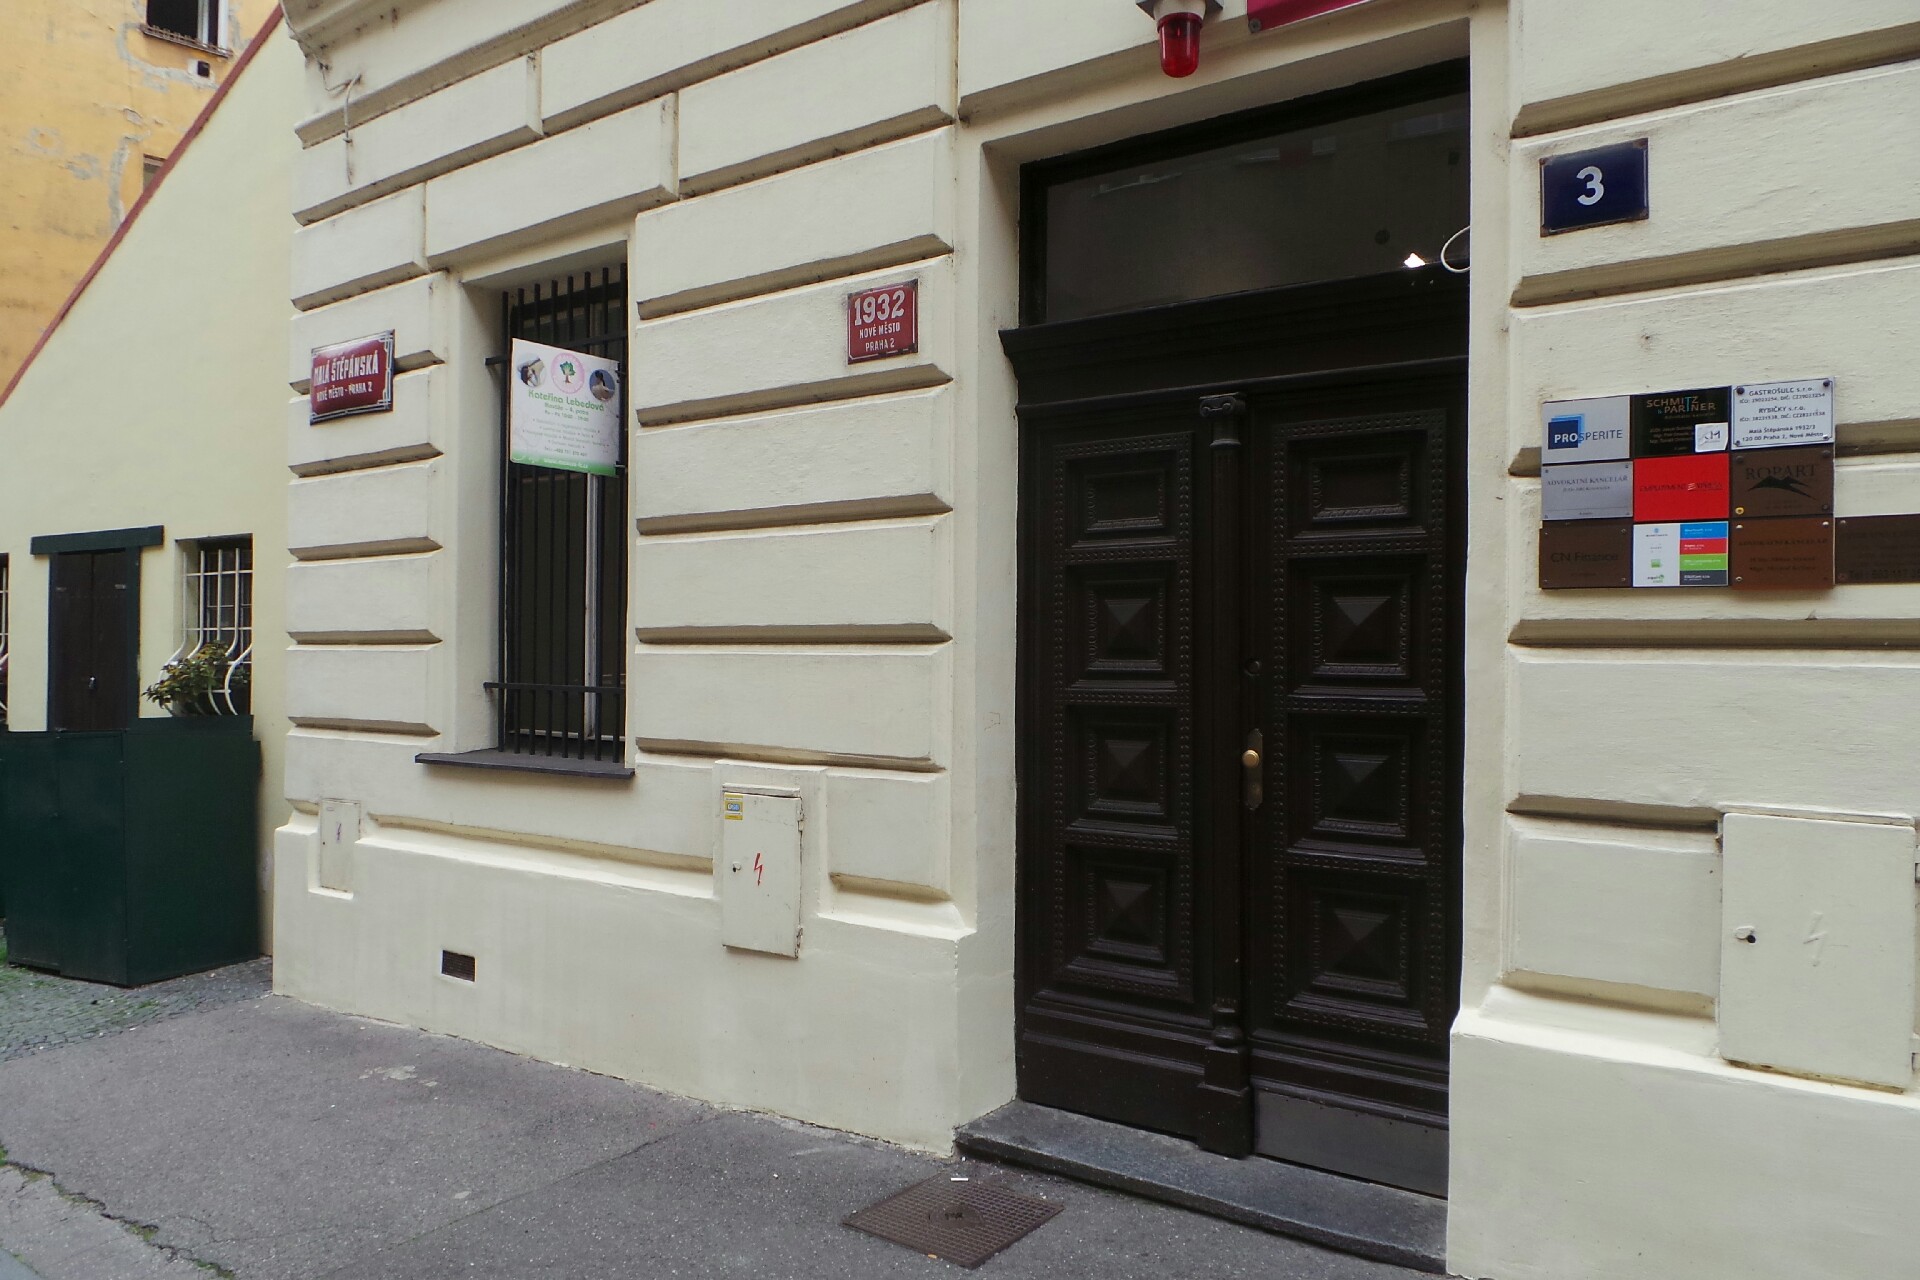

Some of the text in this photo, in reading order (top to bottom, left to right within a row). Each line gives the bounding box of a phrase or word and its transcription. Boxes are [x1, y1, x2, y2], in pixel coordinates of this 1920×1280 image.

[1576, 165, 1605, 206] 3
[854, 289, 905, 326] 1932
[859, 322, 901, 339] NOVÉ MĚSTO
[865, 338, 895, 352] PRAHA 2
[313, 349, 379, 387] MALÁ ŠTĚPÁNSKÁ
[317, 387, 328, 402] NOVÉ
[328, 385, 344, 399] MĚSTO
[348, 382, 367, 396] PRAHA
[367, 381, 373, 393] 2
[1748, 387, 1794, 397] GASTROŠULC
[528, 389, 564, 404] Kateřina
[566, 396, 605, 412] Lebedová
[1646, 396, 1699, 410] SCHMITZ
[1664, 401, 1716, 414] PARTNER
[1758, 406, 1787, 414] RYBIČKY
[1554, 429, 1624, 444] PROSPERITE
[1745, 464, 1820, 480] ROPART
[1550, 552, 1571, 563] CN
